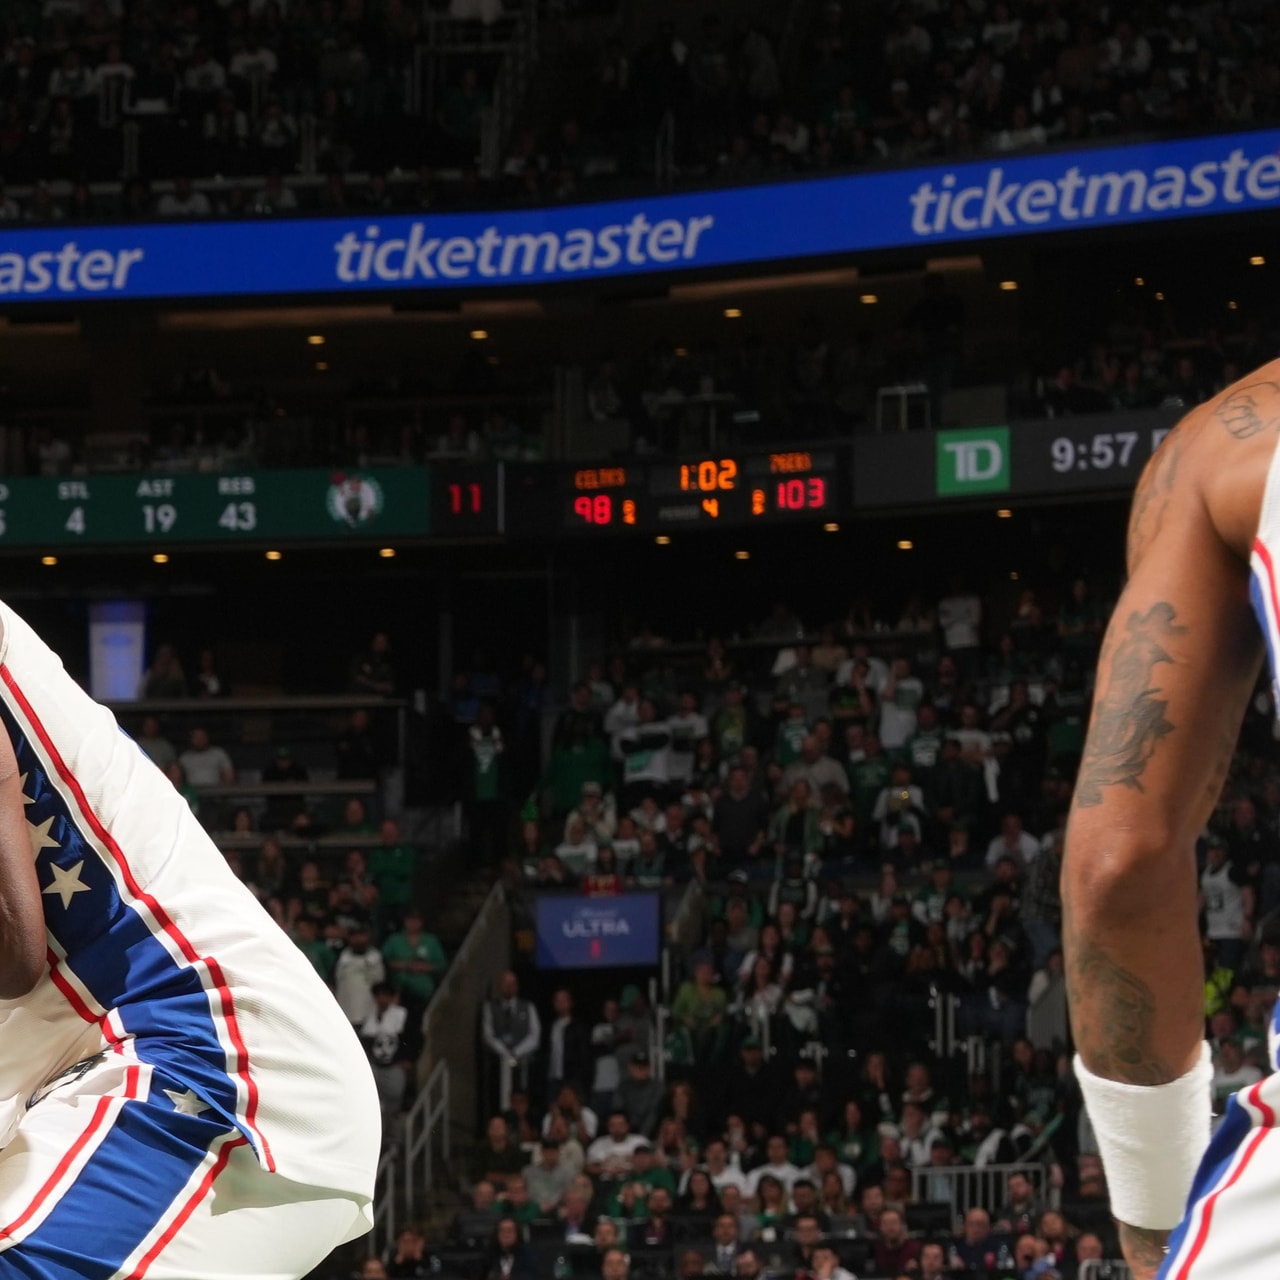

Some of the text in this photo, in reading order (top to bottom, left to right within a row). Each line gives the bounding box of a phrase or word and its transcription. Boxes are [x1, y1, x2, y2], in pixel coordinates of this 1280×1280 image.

[335, 214, 712, 283] ticketmaster
[680, 459, 737, 491] 1:02
[944, 439, 1003, 481] TD
[1051, 432, 1138, 472] 9:57
[65, 507, 86, 535] 4
[142, 504, 177, 533] 19
[218, 502, 256, 531] 43
[574, 494, 612, 524] 98
[777, 477, 825, 510] 103
